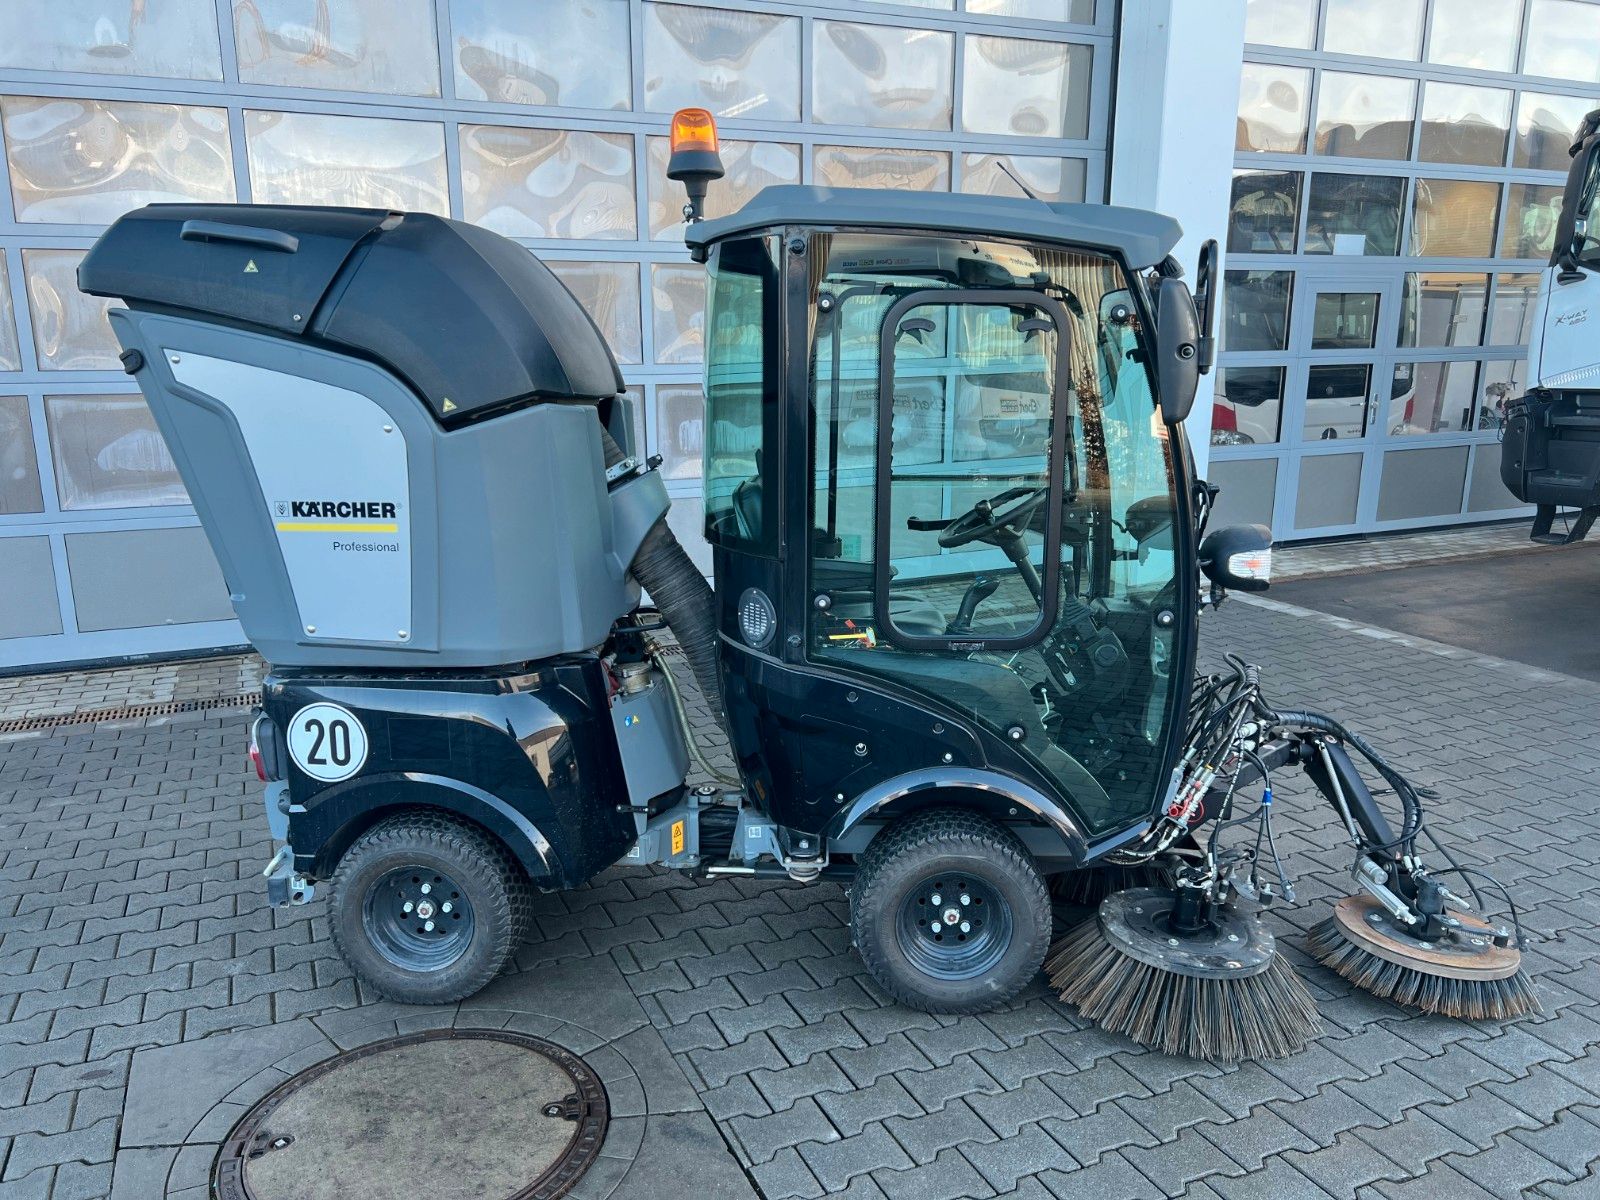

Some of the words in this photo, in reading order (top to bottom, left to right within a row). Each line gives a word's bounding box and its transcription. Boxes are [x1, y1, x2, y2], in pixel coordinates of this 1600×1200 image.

[291, 501, 396, 518] KÄRCHER
[333, 541, 400, 552] Professional
[304, 718, 351, 766] 20
